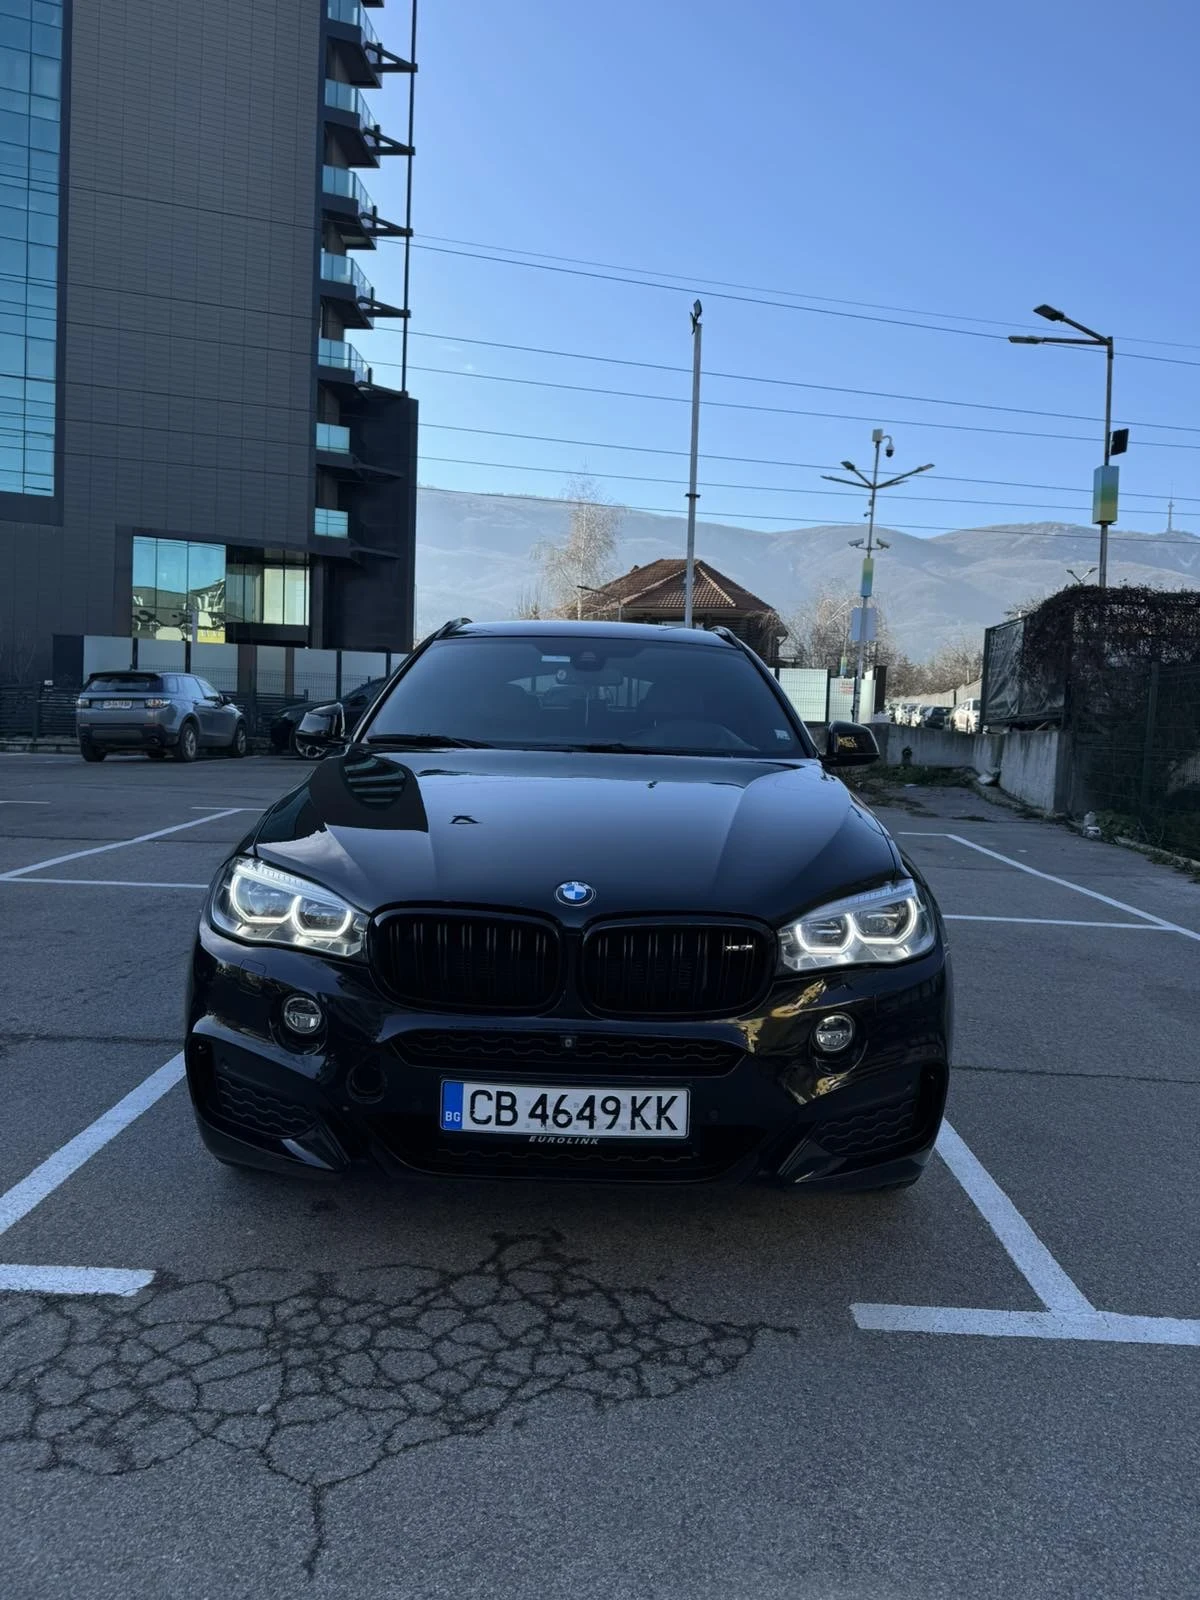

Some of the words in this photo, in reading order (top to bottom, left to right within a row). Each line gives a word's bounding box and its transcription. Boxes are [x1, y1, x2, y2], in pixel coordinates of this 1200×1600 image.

[470, 1089, 518, 1127] CB
[528, 1093, 621, 1130] 4649
[630, 1095, 679, 1131] KK
[445, 1111, 461, 1122] BG
[528, 1135, 600, 1145] EUROLINK
